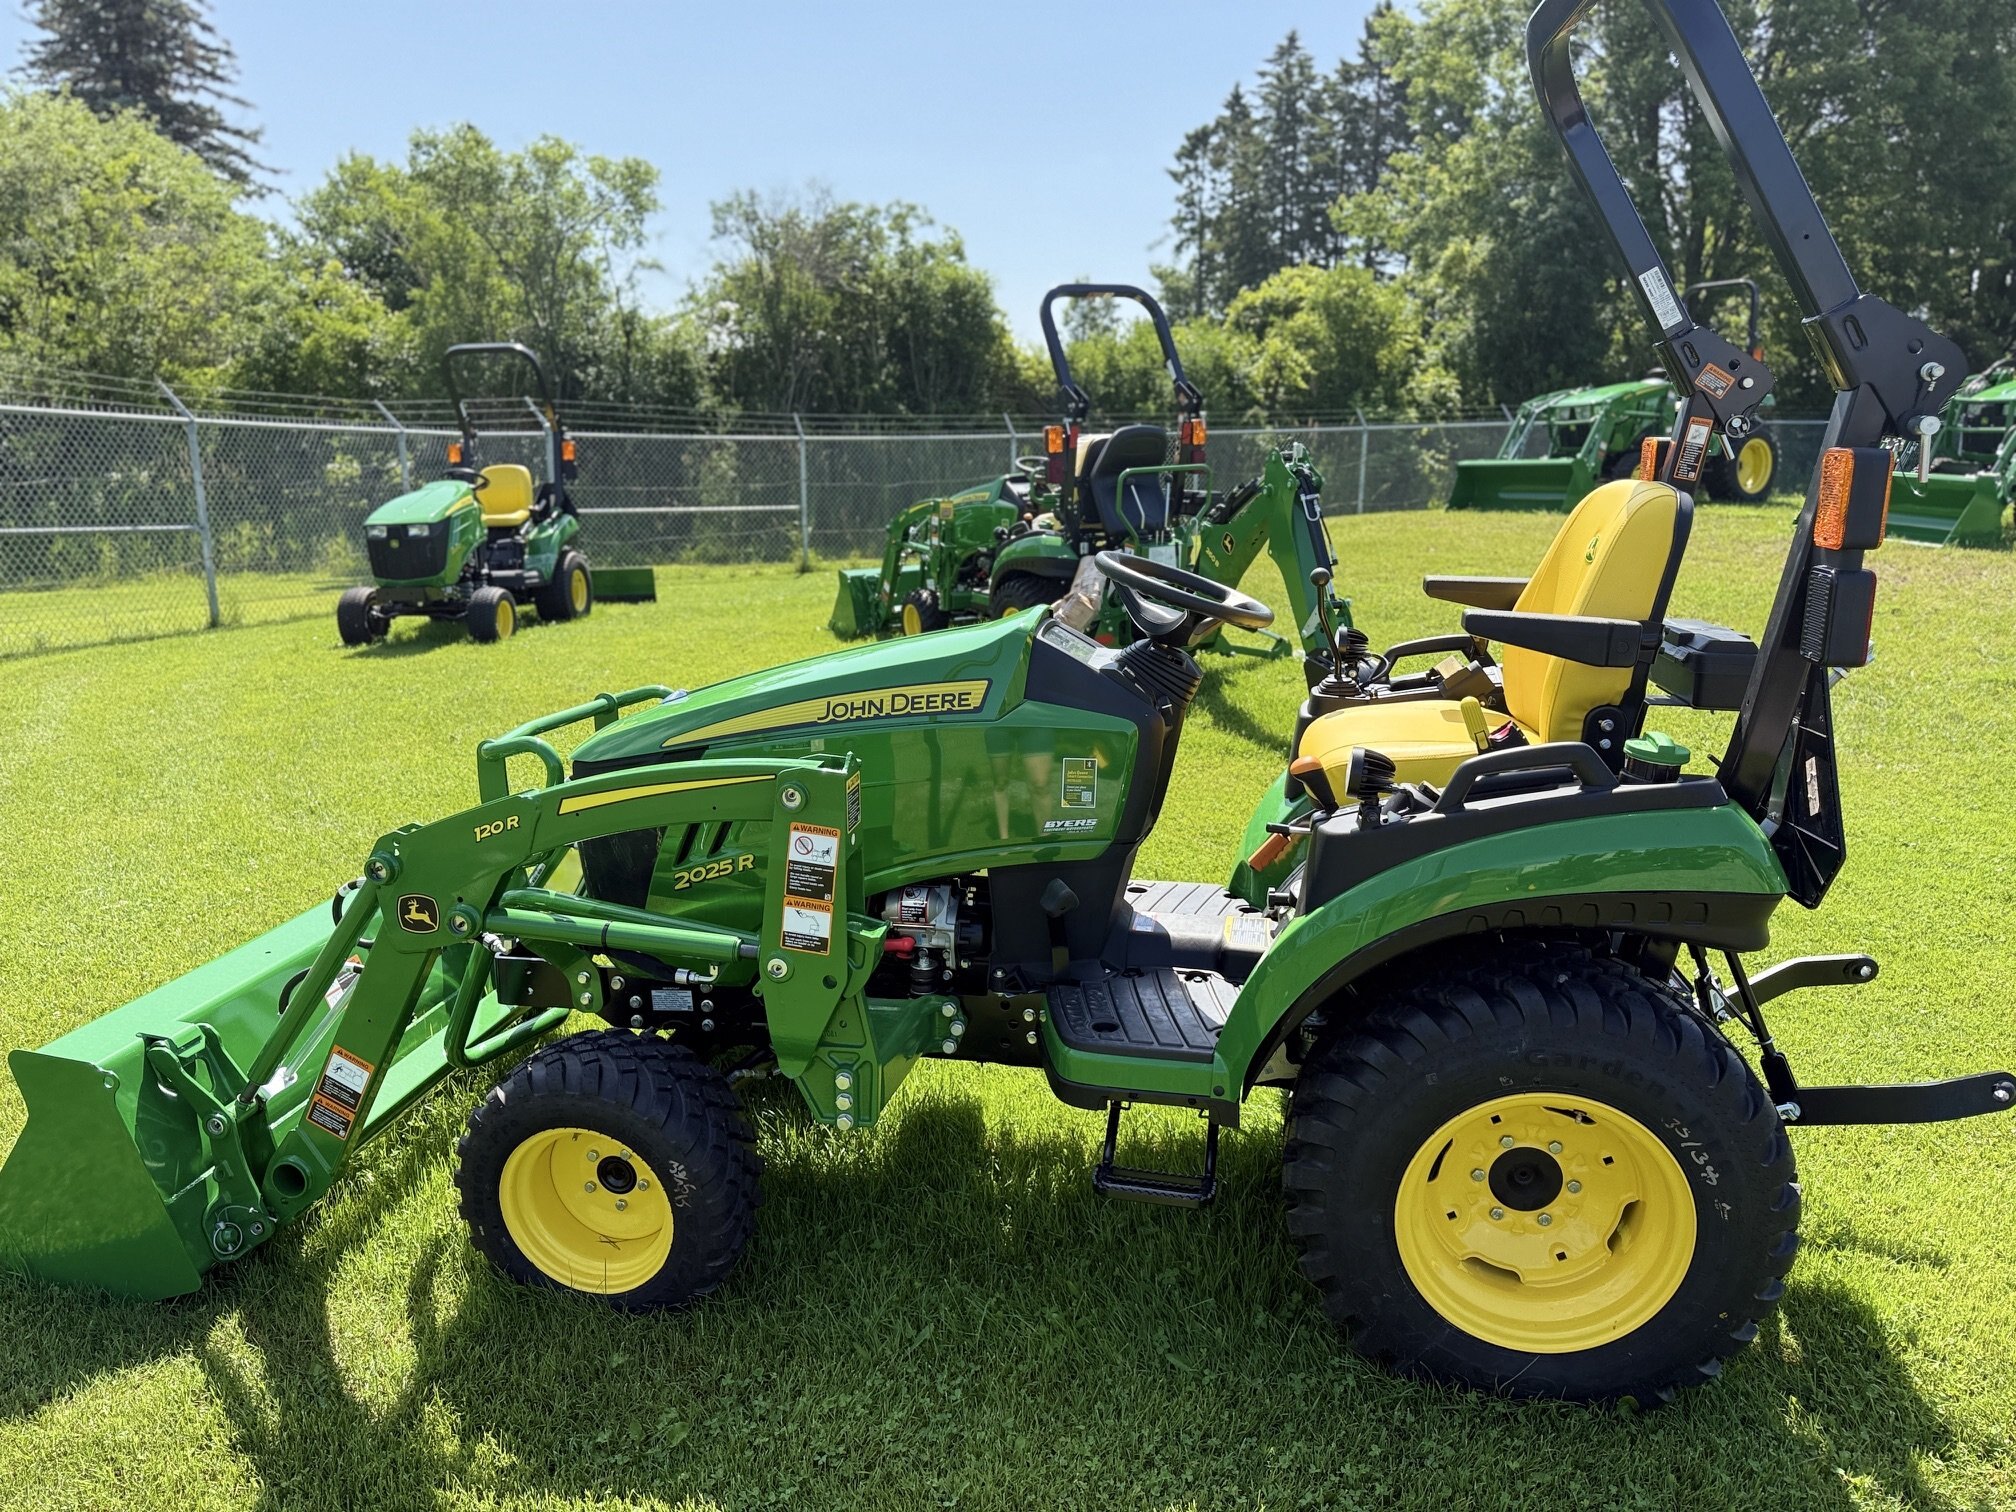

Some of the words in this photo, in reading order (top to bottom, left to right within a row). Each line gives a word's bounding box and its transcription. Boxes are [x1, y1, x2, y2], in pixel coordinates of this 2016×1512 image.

[817, 698, 884, 721] JOHN
[891, 692, 972, 712] DEERE
[474, 821, 504, 842] 120
[506, 815, 519, 830] R
[800, 824, 838, 837] WARNING
[1044, 818, 1098, 828] BYERS
[674, 859, 734, 890] 2025
[738, 854, 754, 872] R
[793, 900, 831, 912] WARNING
[343, 1053, 369, 1070] WARNING
[325, 1100, 350, 1118] WARNING
